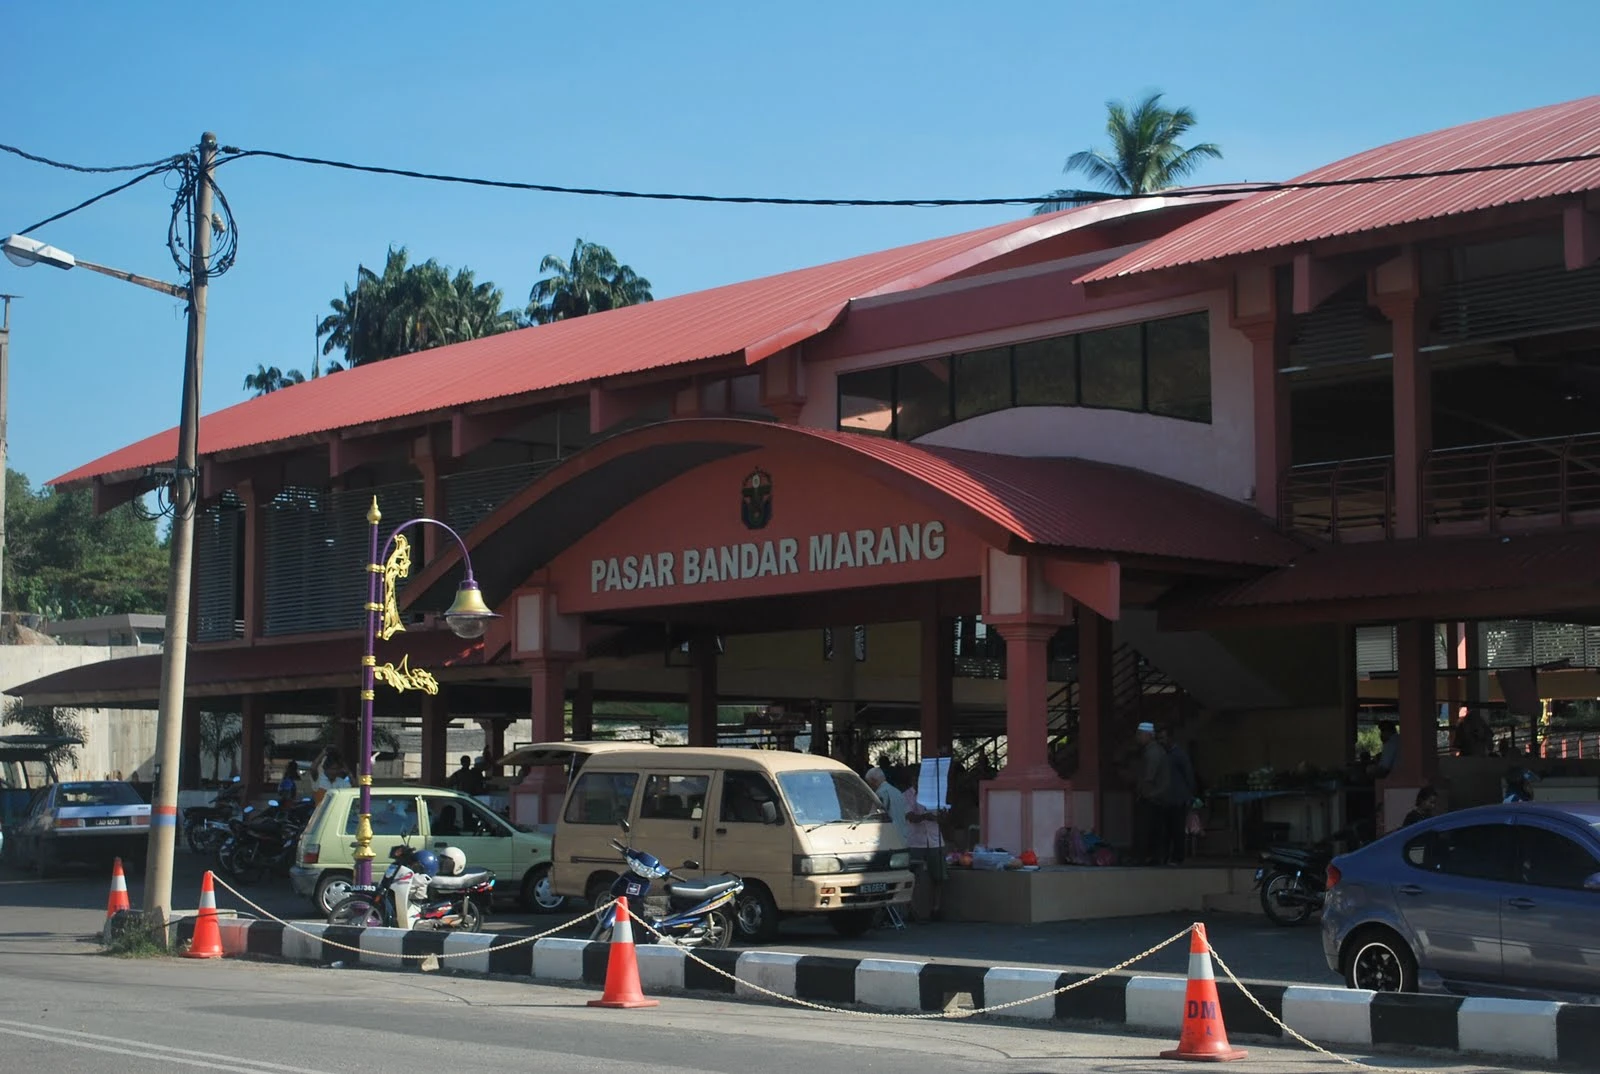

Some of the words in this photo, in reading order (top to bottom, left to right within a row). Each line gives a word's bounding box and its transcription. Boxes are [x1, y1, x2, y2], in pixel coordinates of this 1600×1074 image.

[591, 551, 676, 593] PASAR
[683, 537, 800, 586] BANDAR
[808, 520, 947, 572] MARANG
[1187, 1000, 1217, 1020] DM
